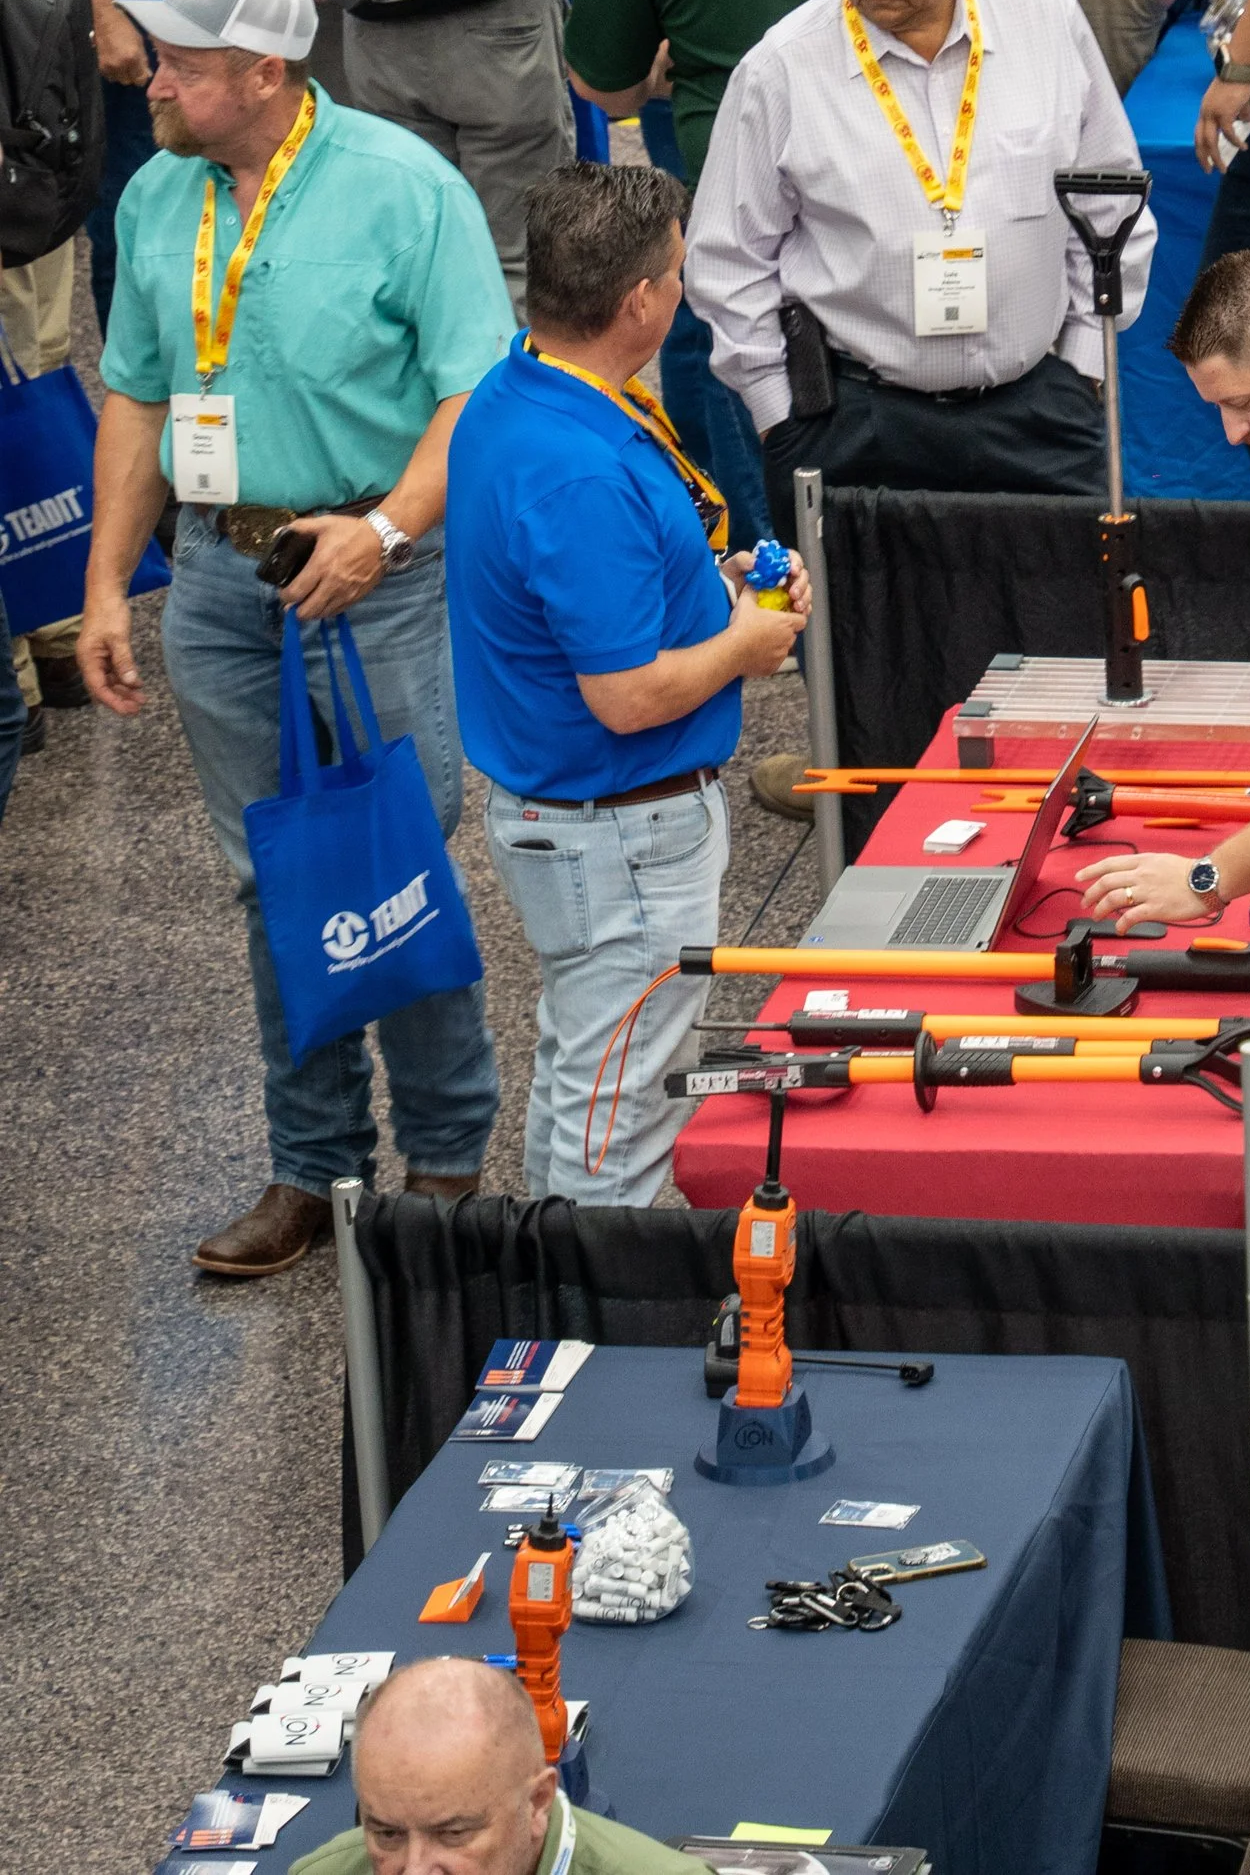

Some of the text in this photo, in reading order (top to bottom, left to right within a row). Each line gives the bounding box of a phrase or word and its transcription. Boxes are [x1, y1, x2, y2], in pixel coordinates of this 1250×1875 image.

[4, 487, 84, 542] TEADIT
[742, 1429, 774, 1446] ION
[285, 1717, 308, 1747] ION
